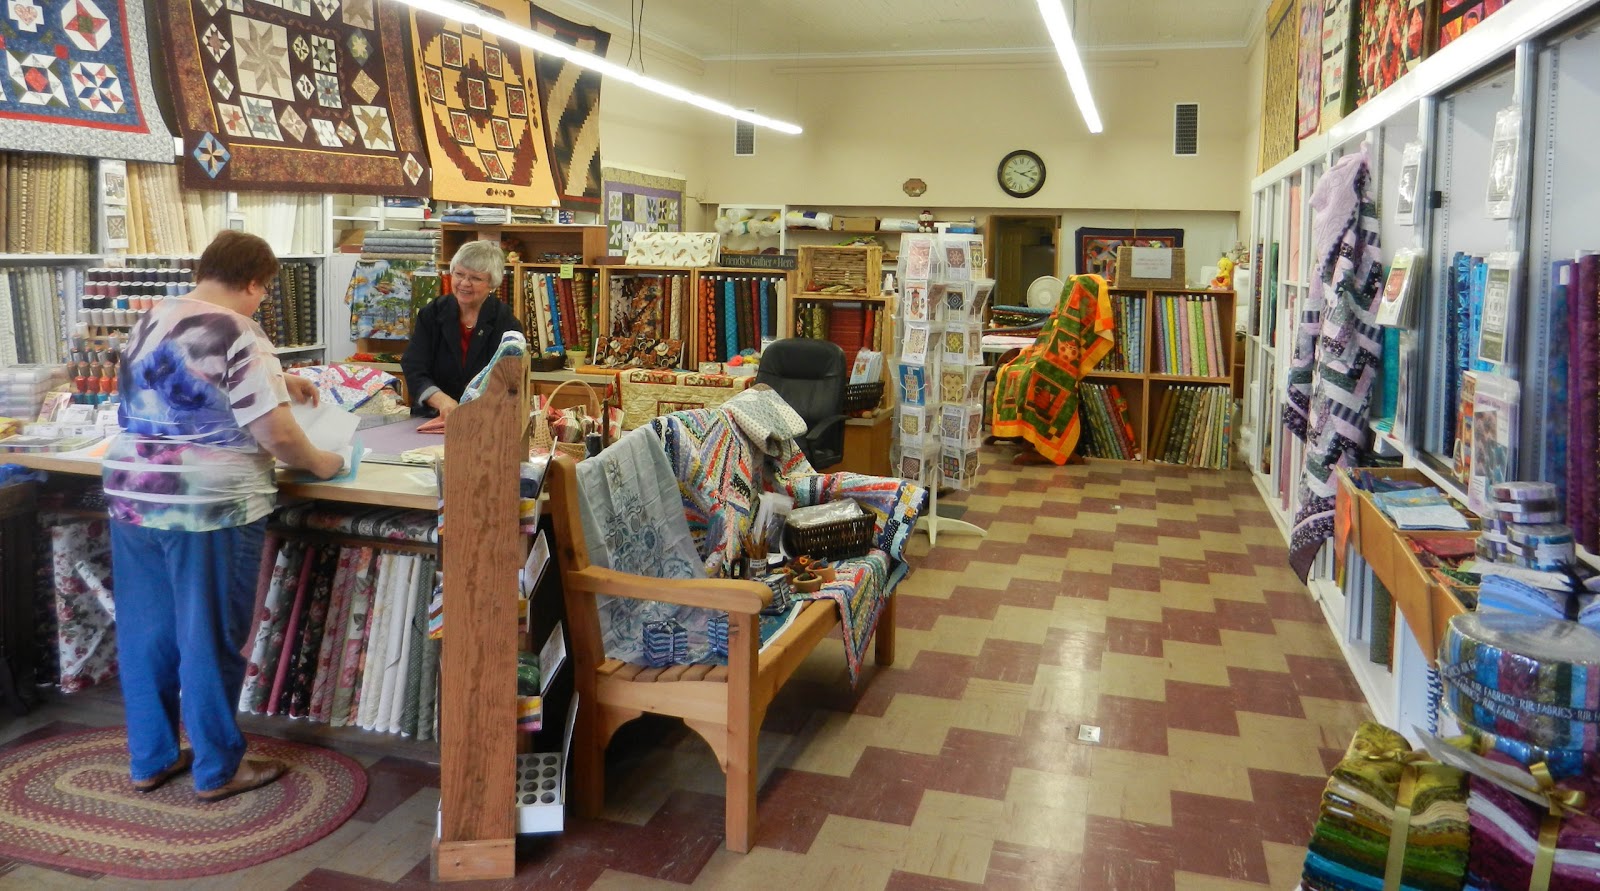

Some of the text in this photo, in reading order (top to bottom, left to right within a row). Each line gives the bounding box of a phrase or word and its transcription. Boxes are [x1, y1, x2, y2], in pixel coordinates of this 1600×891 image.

[721, 256, 794, 268] Friends Gather Here
[1484, 686, 1515, 706] FABRICS
[1537, 703, 1573, 719] FABRICS
